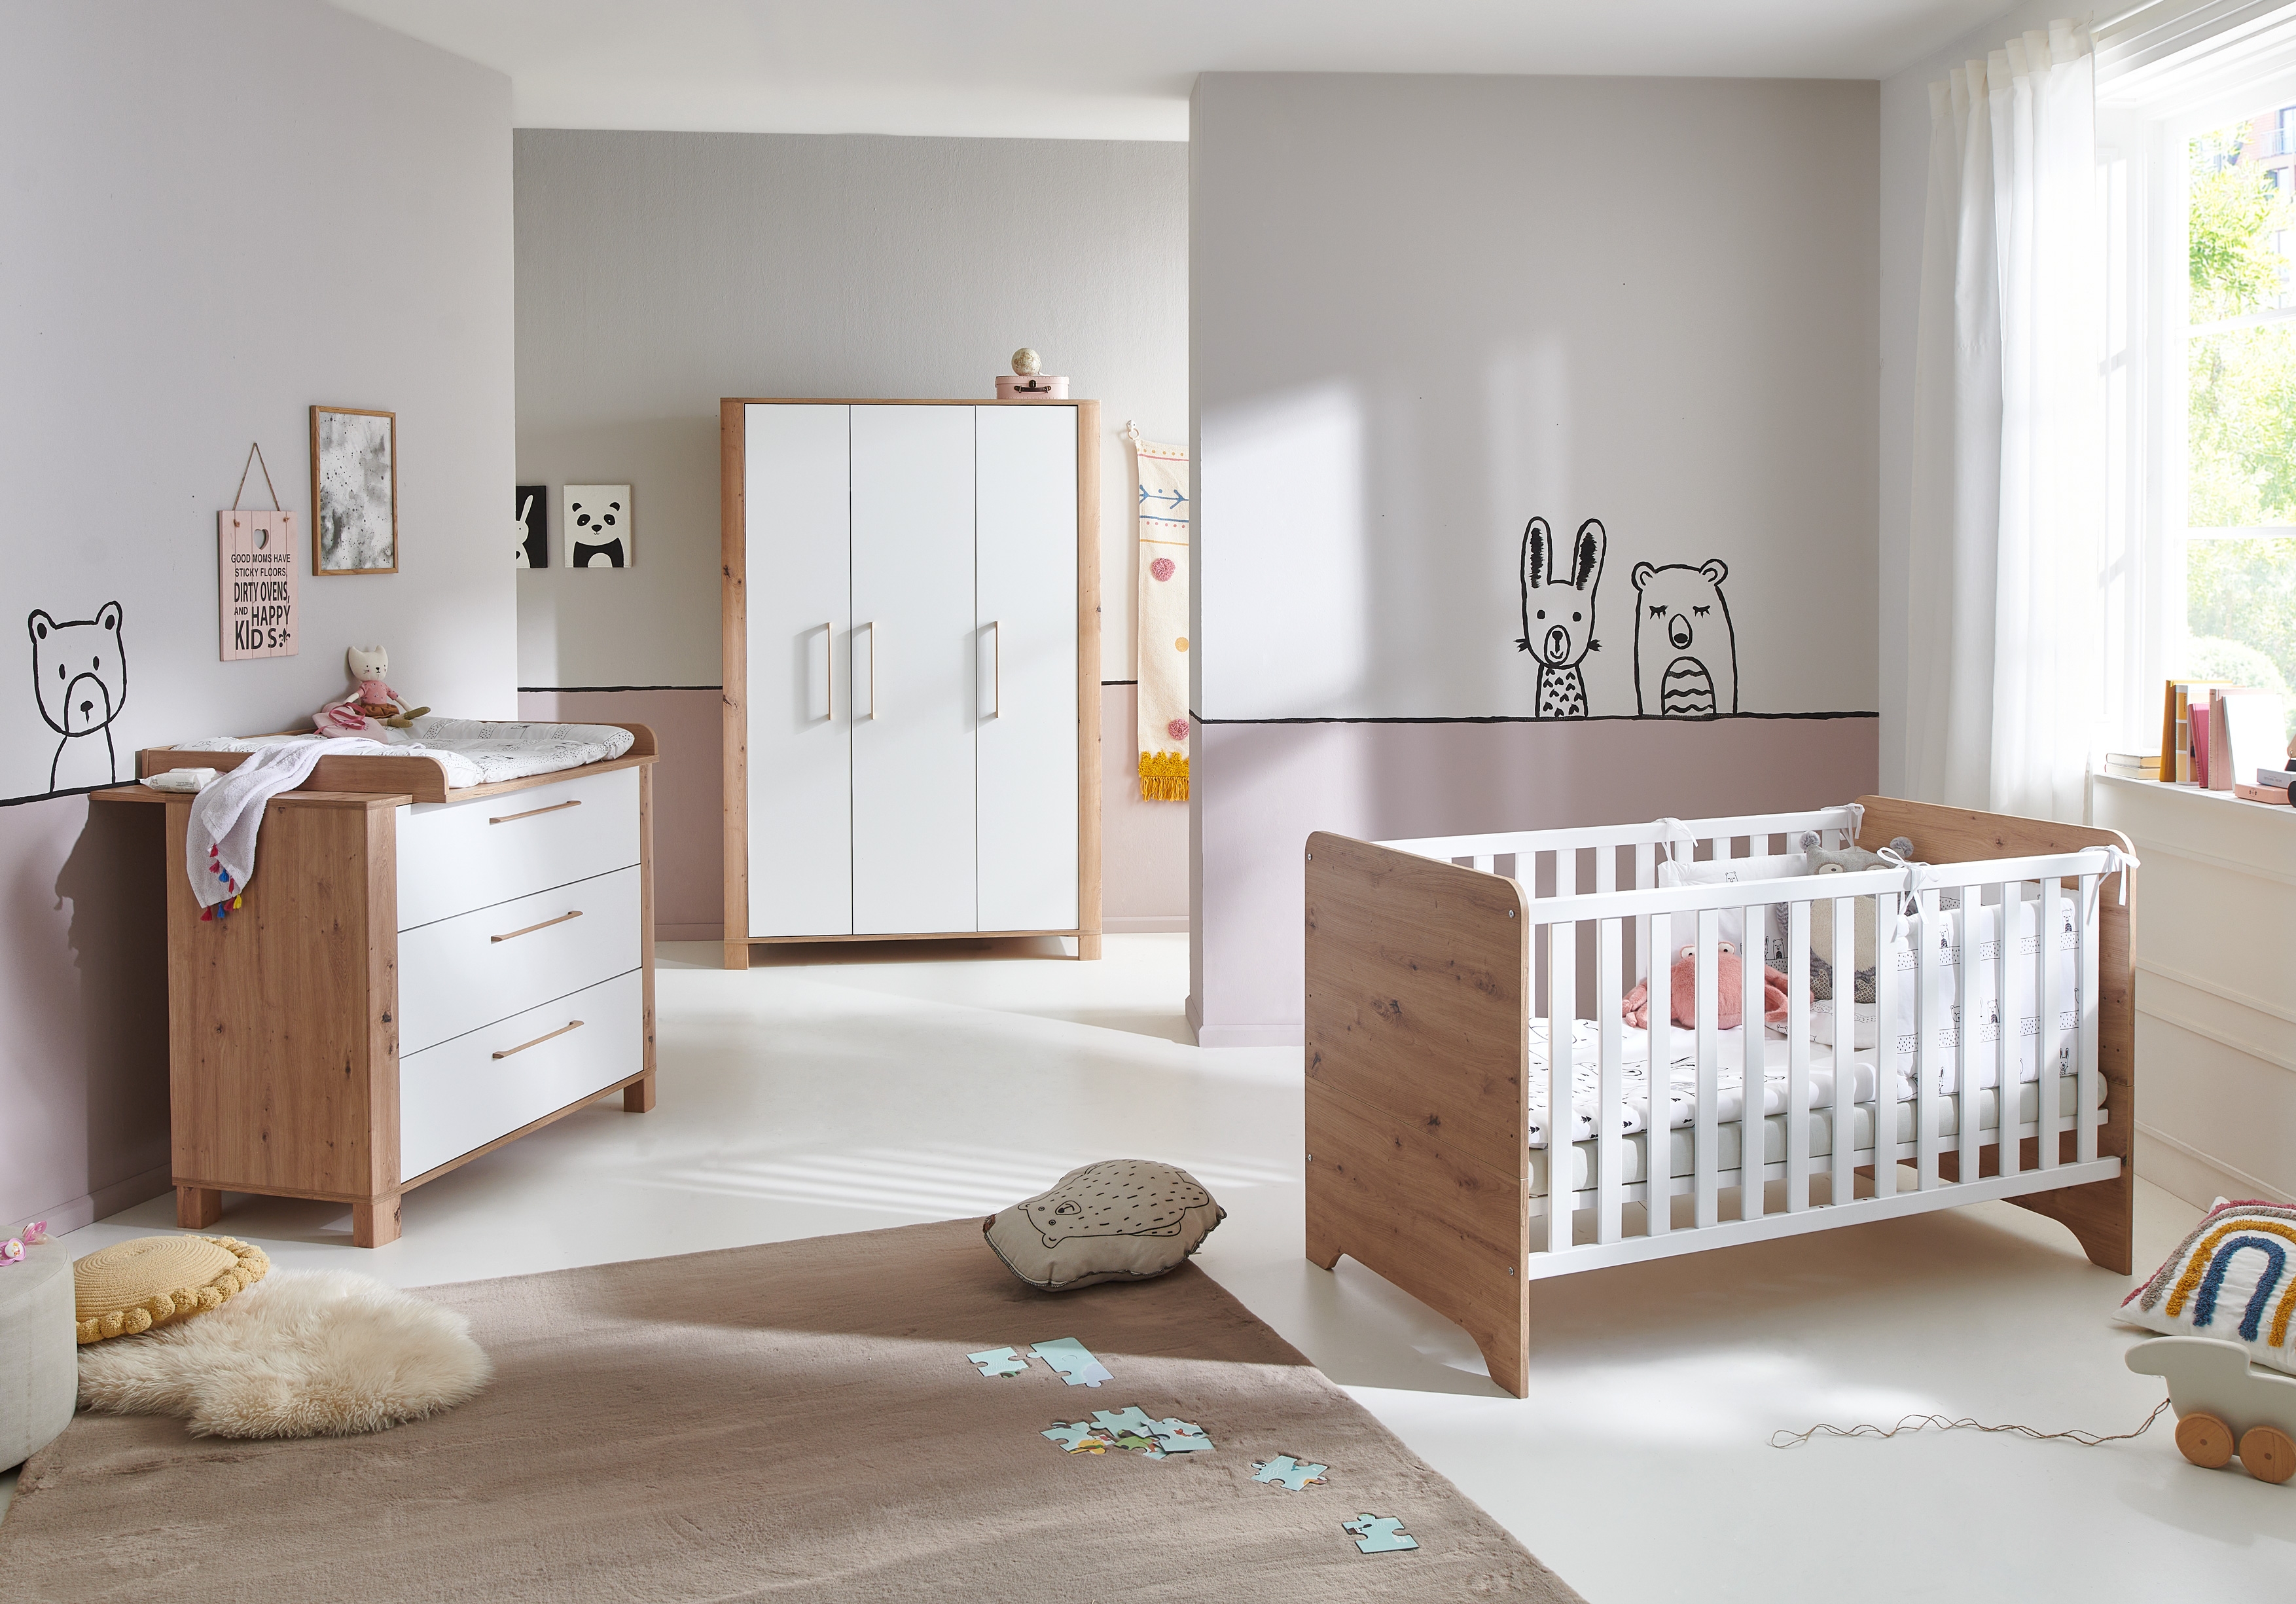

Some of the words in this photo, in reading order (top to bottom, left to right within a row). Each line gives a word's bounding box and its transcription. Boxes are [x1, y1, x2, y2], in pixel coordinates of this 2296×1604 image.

[231, 554, 251, 563] GOOD
[253, 554, 272, 563] MOMS
[274, 554, 291, 563] HAVE
[235, 568, 259, 577] STICKY
[234, 581, 259, 602] DIRTY
[260, 581, 290, 604] OVENS,
[234, 606, 248, 615] AND
[251, 605, 291, 627] HAPPY
